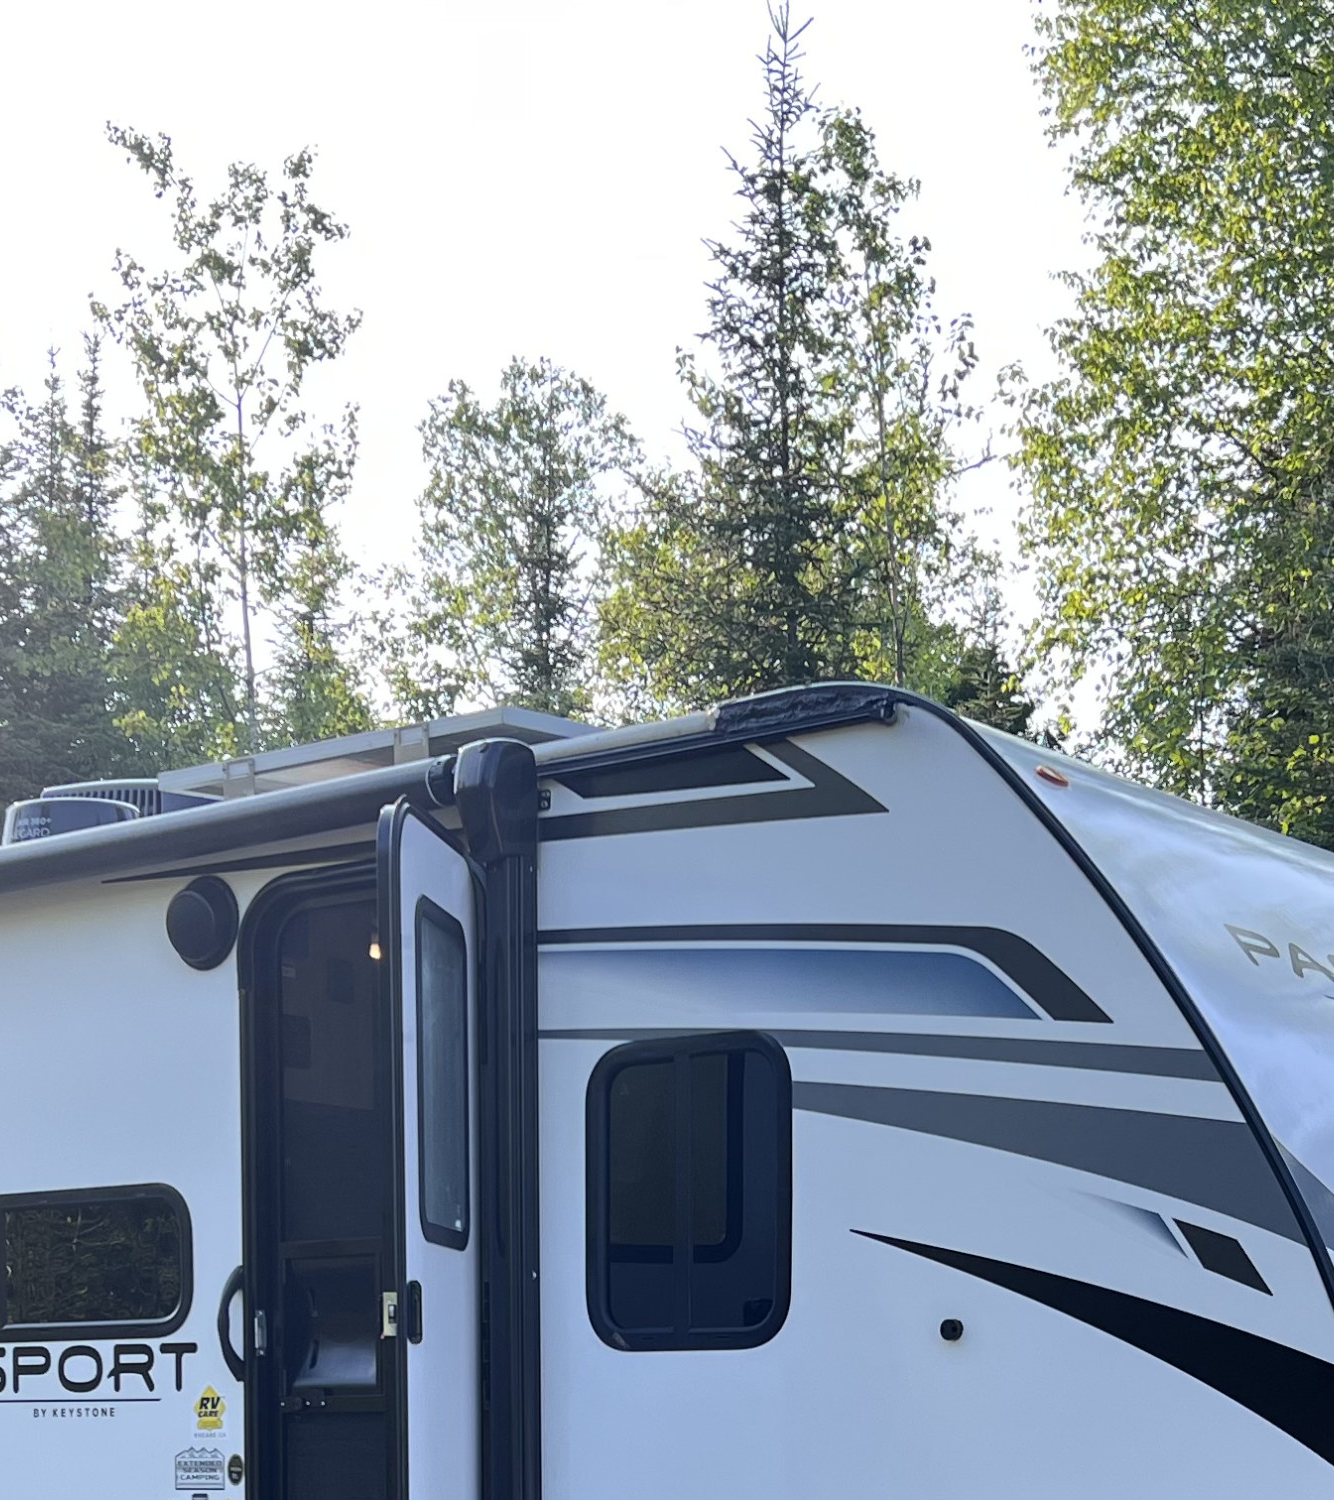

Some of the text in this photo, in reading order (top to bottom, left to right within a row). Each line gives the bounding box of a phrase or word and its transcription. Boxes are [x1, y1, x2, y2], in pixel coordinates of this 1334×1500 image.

[199, 1396, 220, 1410] RV
[33, 1407, 116, 1418] BY KEYSTONE
[197, 1410, 219, 1418] CARE
